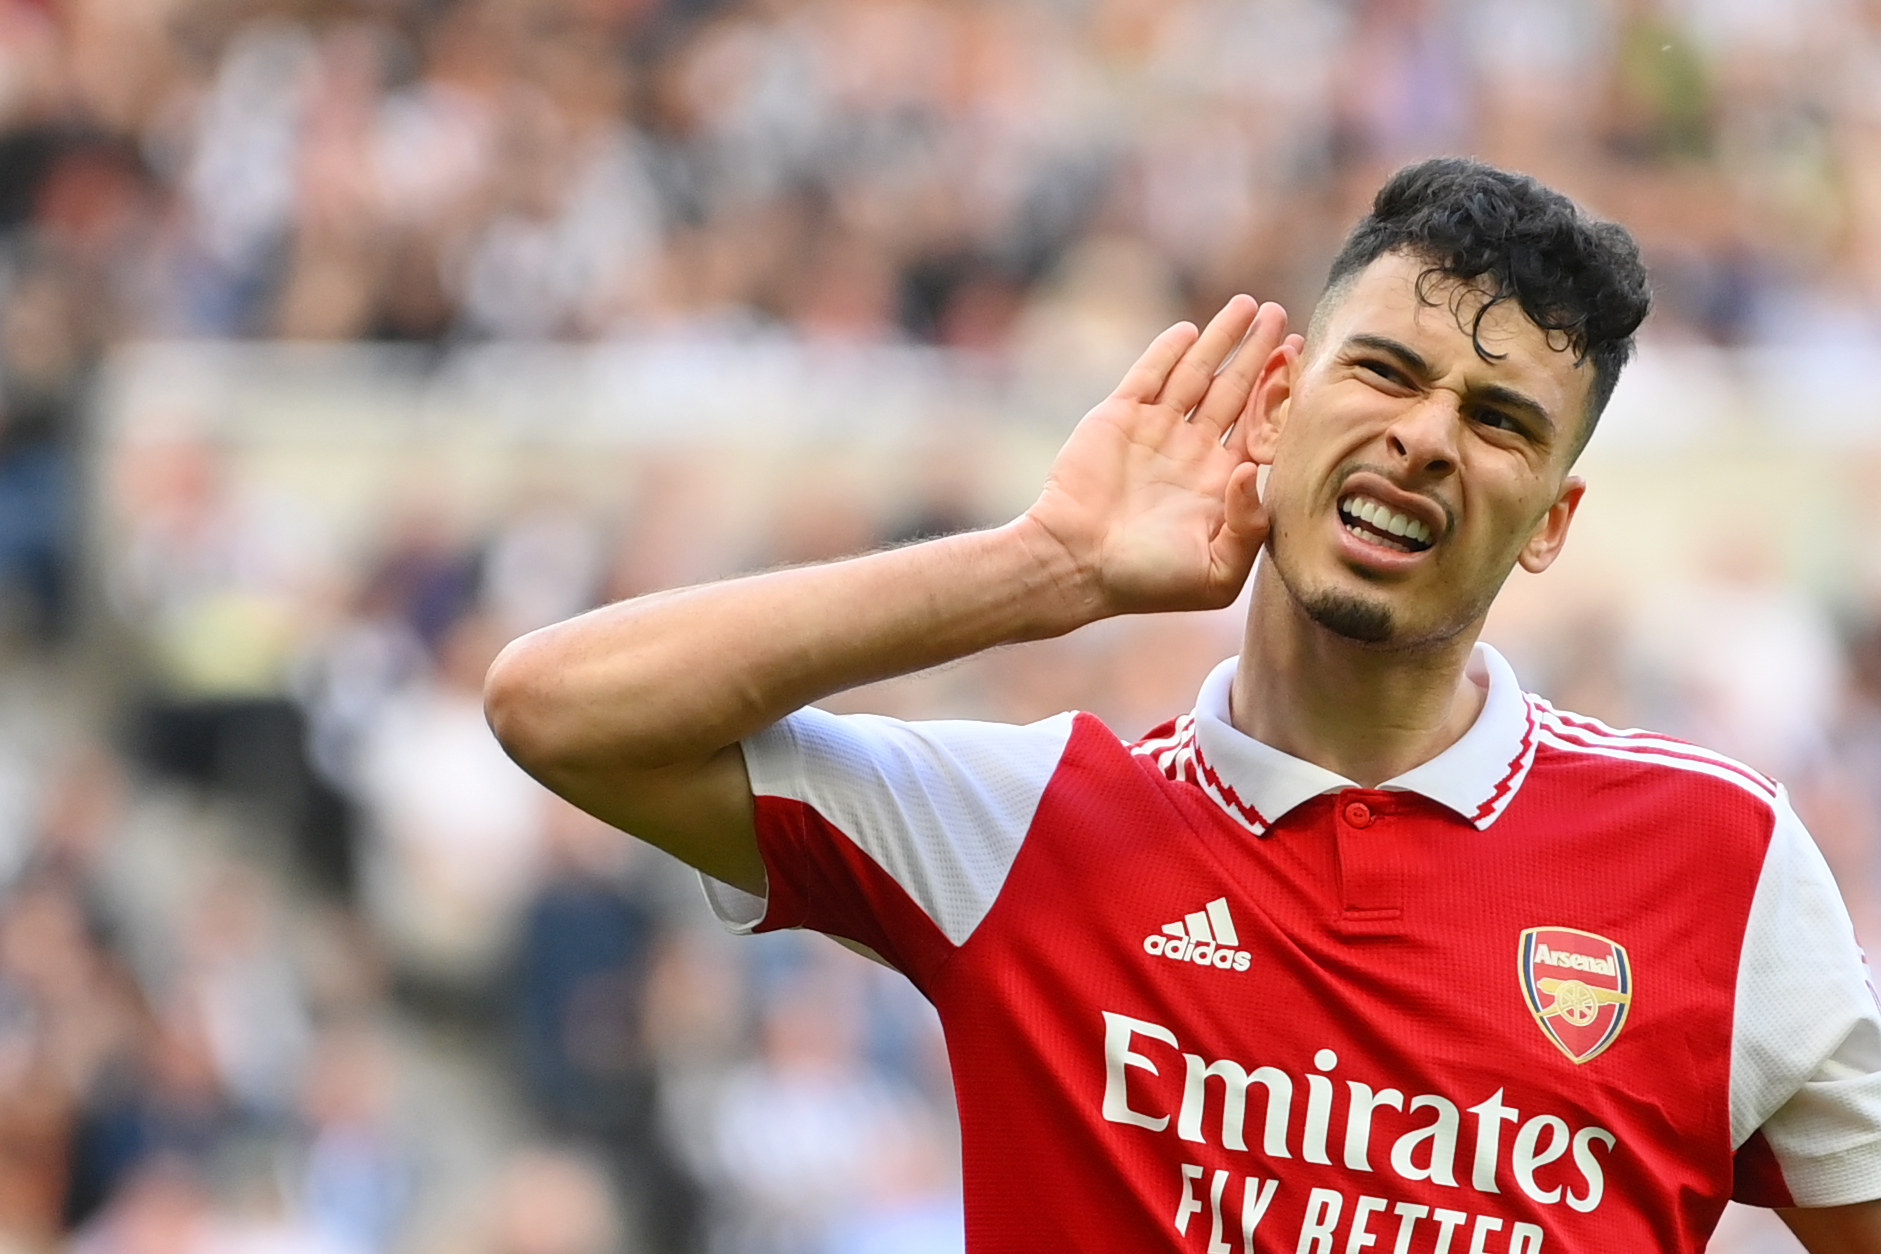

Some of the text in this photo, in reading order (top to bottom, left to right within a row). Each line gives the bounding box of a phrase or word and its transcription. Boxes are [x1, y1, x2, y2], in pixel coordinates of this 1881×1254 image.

[1143, 934, 1251, 971] adidas
[1534, 943, 1616, 976] Arsenal
[1101, 1010, 1617, 1213] Emirates
